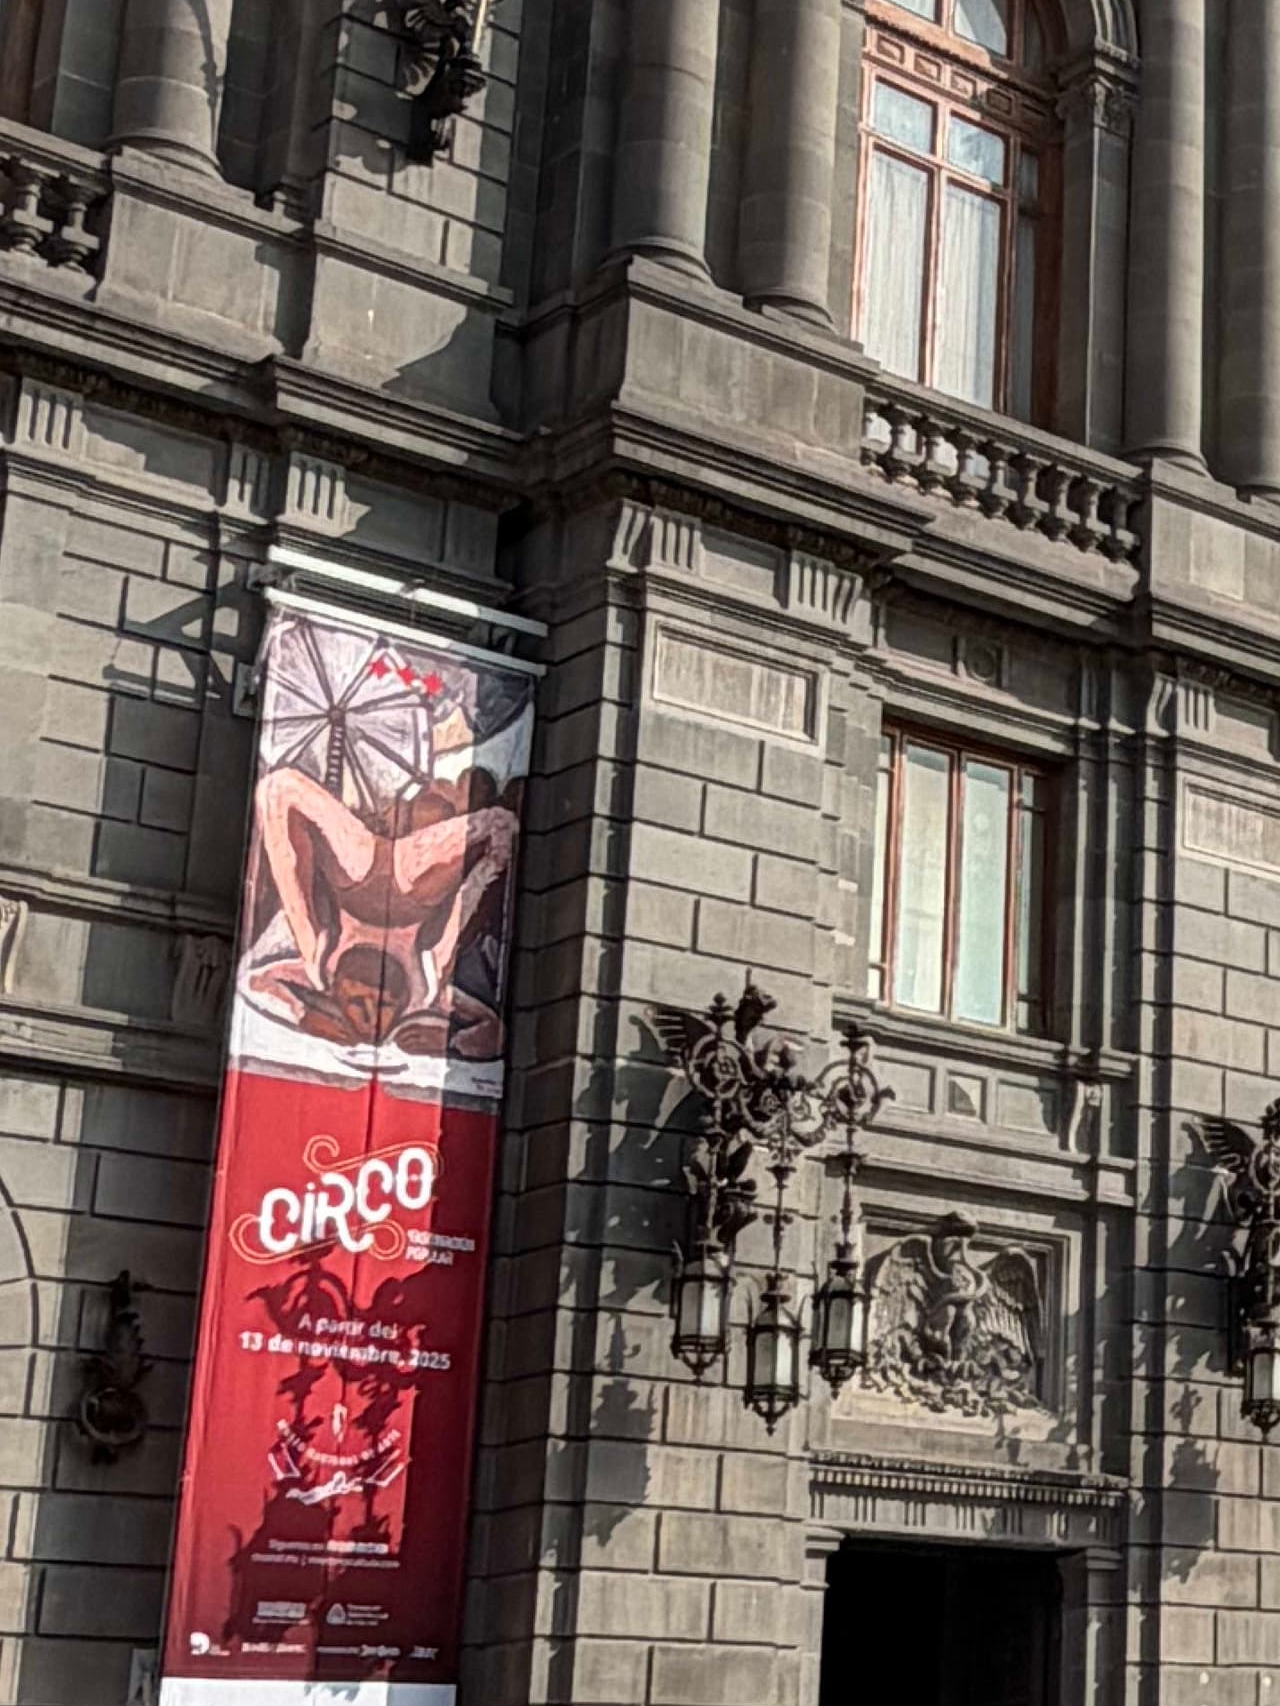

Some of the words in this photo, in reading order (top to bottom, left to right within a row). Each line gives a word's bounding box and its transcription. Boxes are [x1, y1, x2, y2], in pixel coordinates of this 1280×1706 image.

[298, 1313, 312, 1330] A
[315, 1317, 366, 1337] partir
[239, 1330, 264, 1352] 13
[268, 1333, 294, 1353] de
[408, 1348, 451, 1370] 2025
